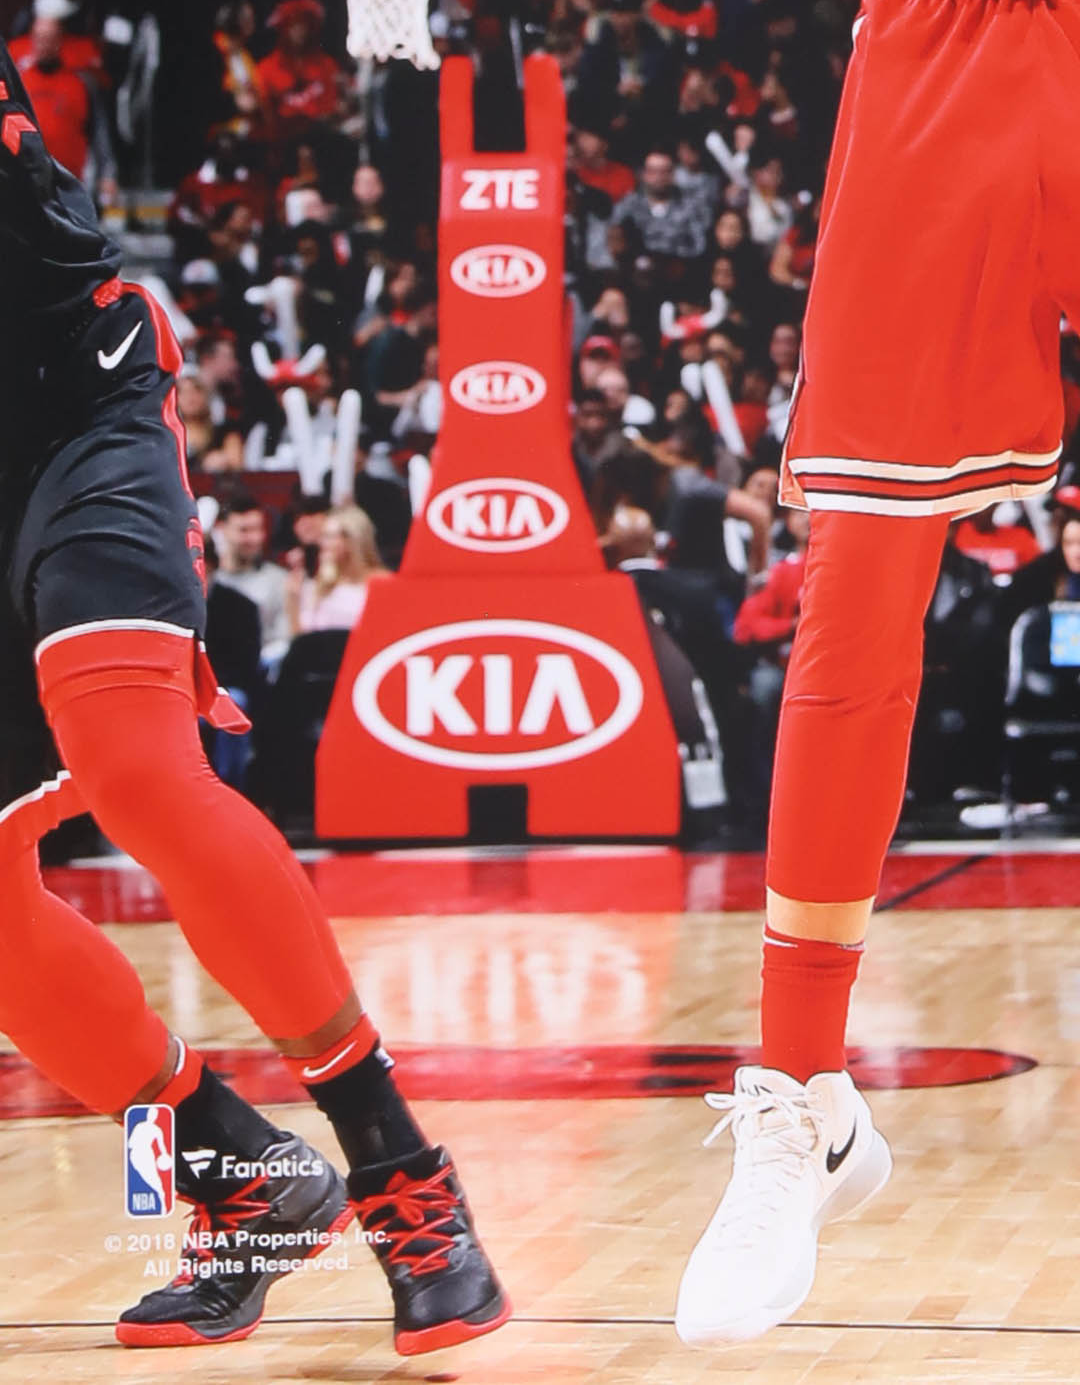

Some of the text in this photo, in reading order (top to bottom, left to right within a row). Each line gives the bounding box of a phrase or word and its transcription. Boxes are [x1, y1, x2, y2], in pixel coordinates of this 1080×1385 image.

[459, 168, 541, 211] ZTE
[450, 493, 547, 537] KIA
[404, 653, 596, 737] KIA
